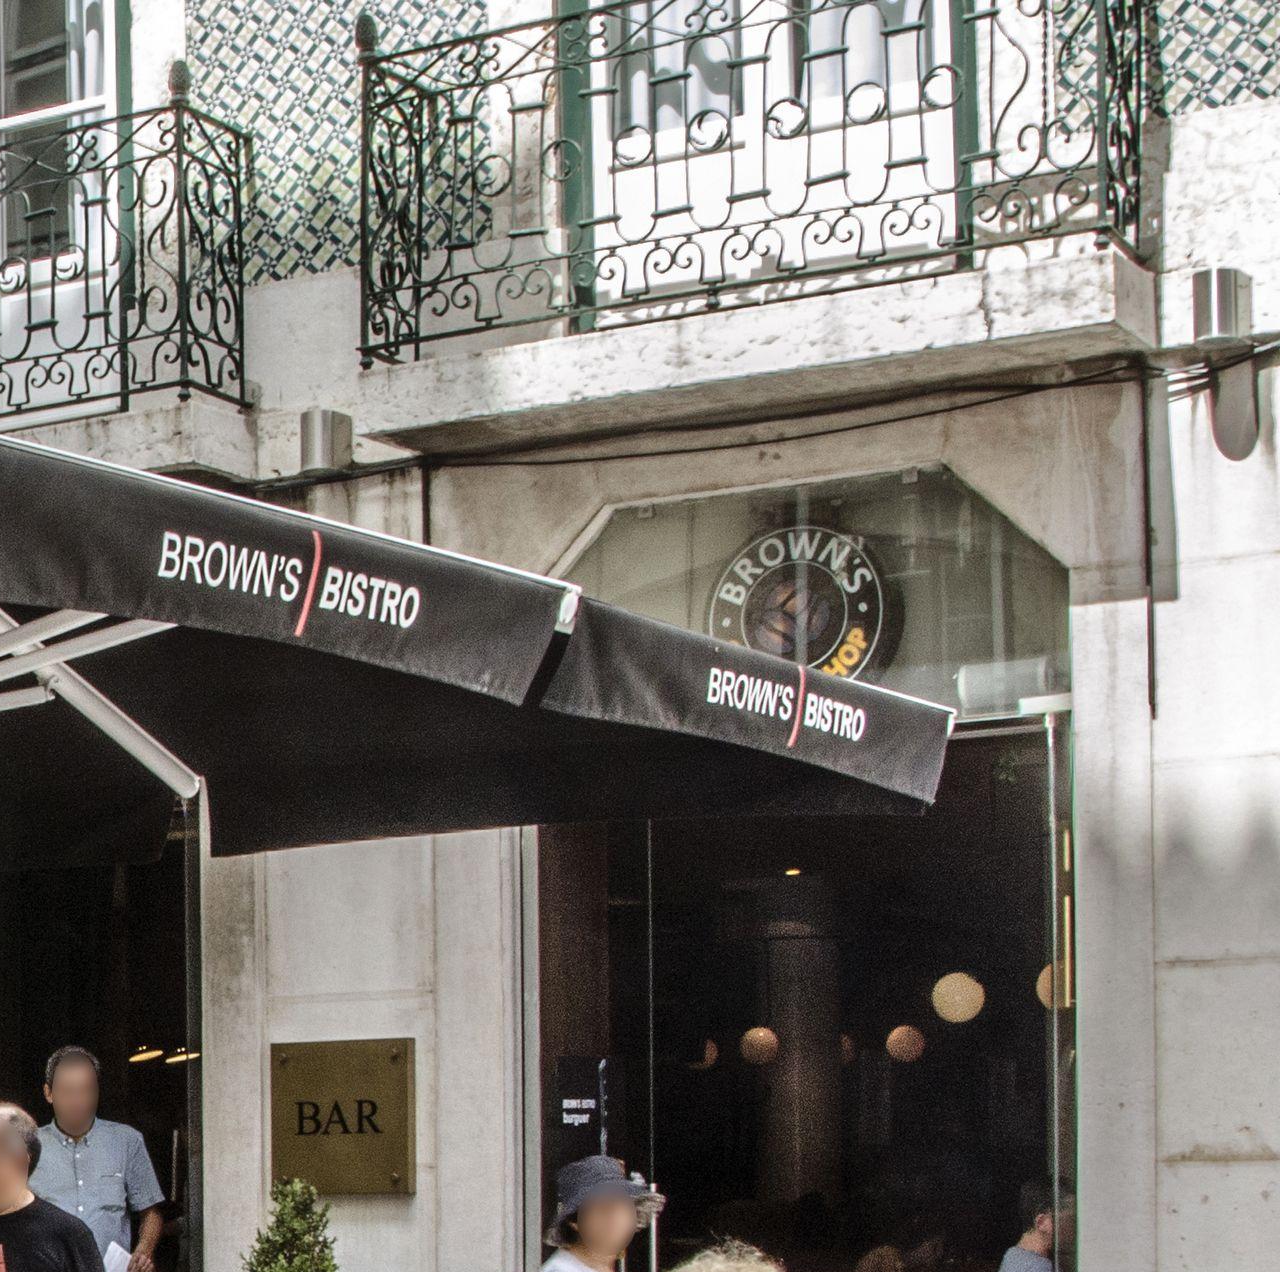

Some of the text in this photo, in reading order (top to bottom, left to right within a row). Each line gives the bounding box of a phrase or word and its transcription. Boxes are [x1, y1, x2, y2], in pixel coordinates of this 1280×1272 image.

[157, 530, 421, 629] BROWN'S BISTRO
[718, 531, 873, 607] BROWN'S
[821, 626, 868, 677] HOP
[706, 667, 867, 742] BROWN'S BISTRO
[294, 1099, 384, 1136] BAR
